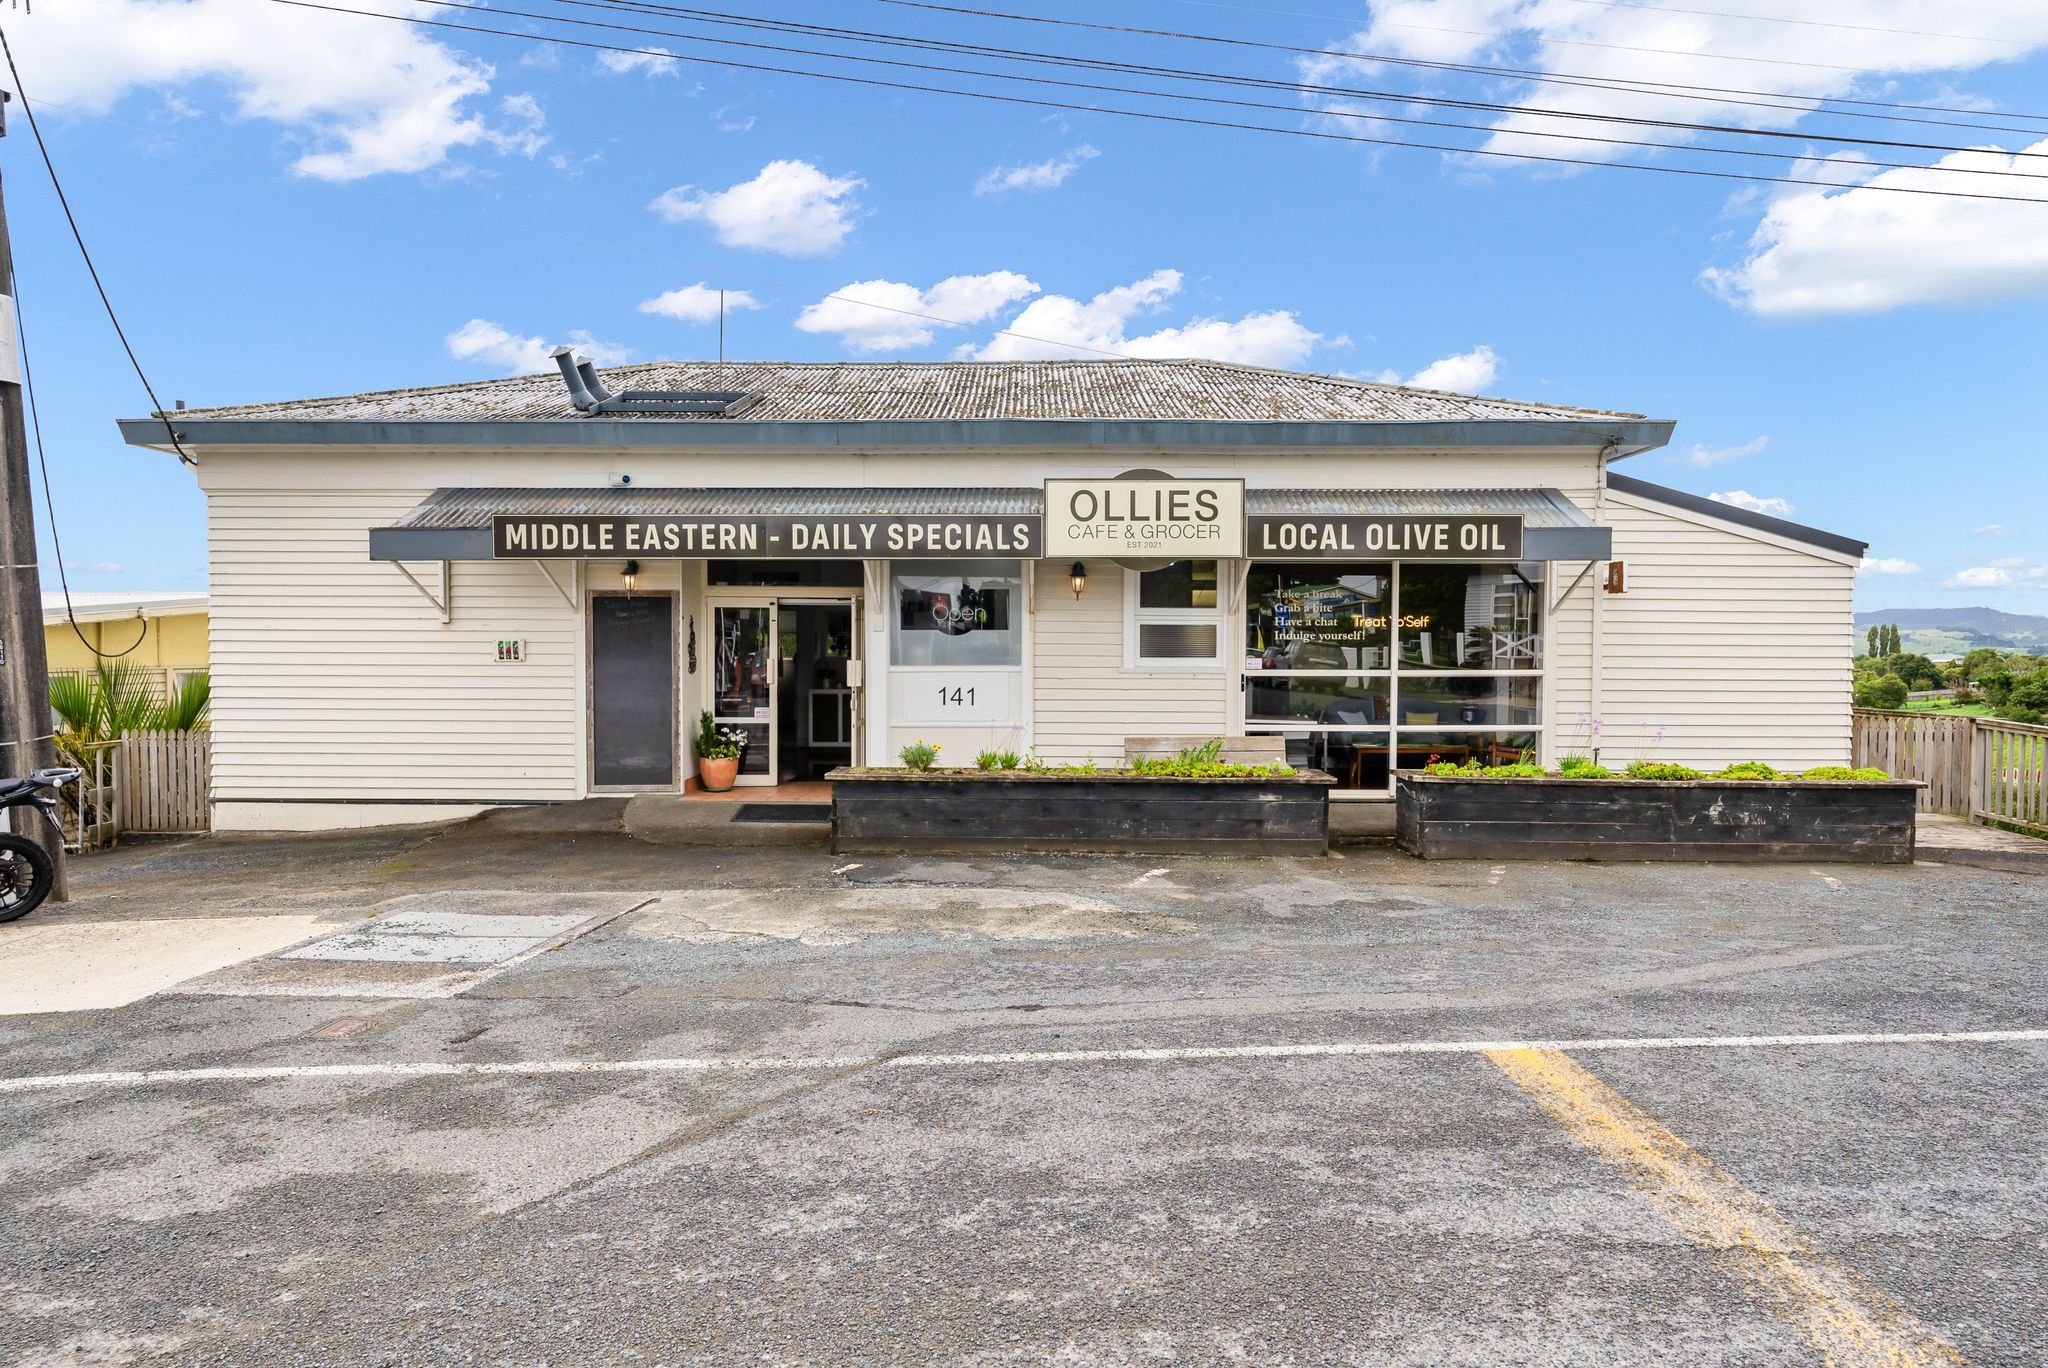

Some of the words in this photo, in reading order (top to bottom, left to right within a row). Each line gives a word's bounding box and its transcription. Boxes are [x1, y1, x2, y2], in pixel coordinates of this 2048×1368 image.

[1070, 490, 1219, 522] OLLIES
[505, 523, 614, 550] MIDDLE
[625, 523, 757, 550] EASTERN
[791, 523, 877, 550] DAILY
[887, 523, 1030, 551] SPECIALS
[1068, 524, 1118, 539] CAFE
[1124, 524, 1136, 539] &
[1141, 524, 1221, 539] GROCER
[1263, 523, 1355, 550] LOCAL
[1365, 523, 1449, 550] OLIVE
[1460, 523, 1506, 550] OIL
[1127, 541, 1142, 549] EST
[1144, 541, 1162, 549] 2021
[1274, 590, 1300, 599] Take
[1311, 589, 1342, 599] break
[1274, 603, 1300, 612] Grab
[1312, 603, 1333, 612] bite
[933, 605, 986, 633] Open
[1274, 616, 1303, 626] Have
[1315, 616, 1337, 626] chat
[1352, 615, 1386, 627] Treat
[1389, 615, 1429, 627] o'Self
[1274, 631, 1316, 642] Indulge
[1319, 630, 1365, 642] yourself!
[938, 687, 975, 705] 141
